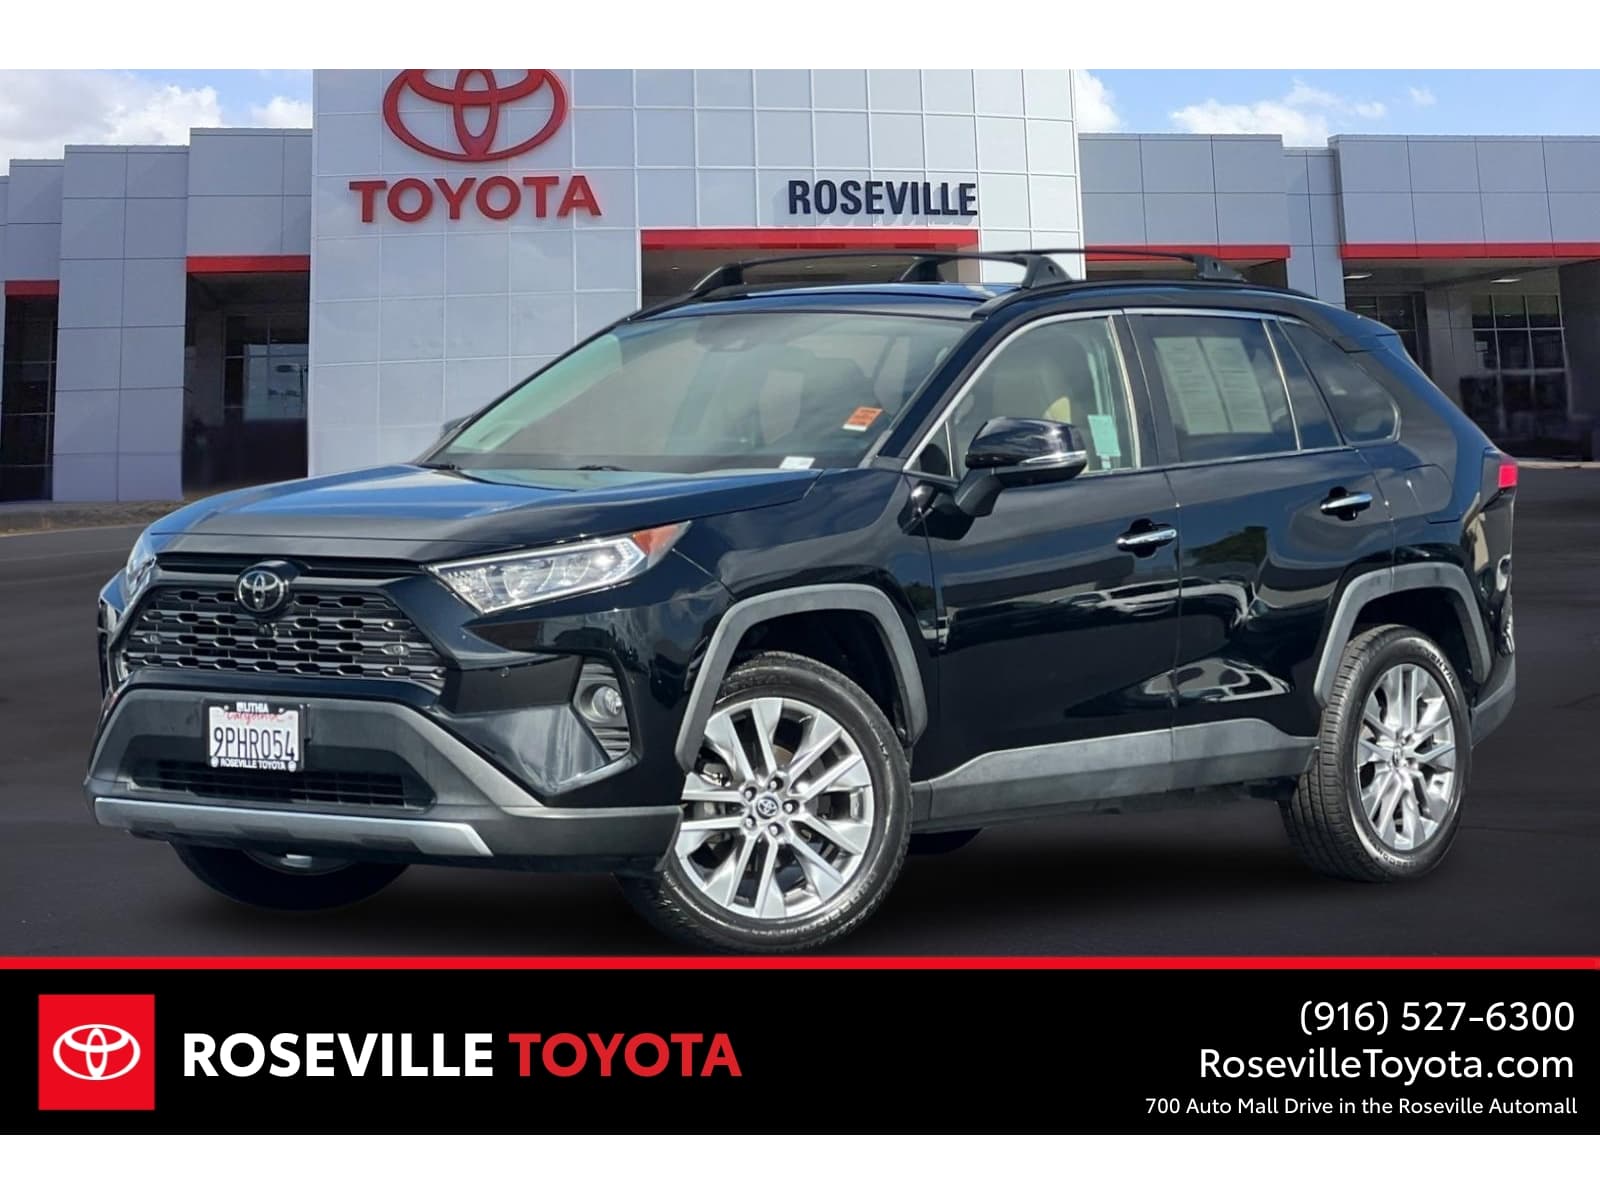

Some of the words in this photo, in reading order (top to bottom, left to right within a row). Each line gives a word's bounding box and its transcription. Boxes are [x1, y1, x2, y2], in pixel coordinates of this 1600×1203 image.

[349, 175, 602, 224] TOYOTA
[788, 179, 979, 217] ROSEVILLE
[213, 727, 295, 760] 9PHR054
[220, 758, 258, 769] ROSEVILLE
[258, 760, 287, 771] TOYOTA
